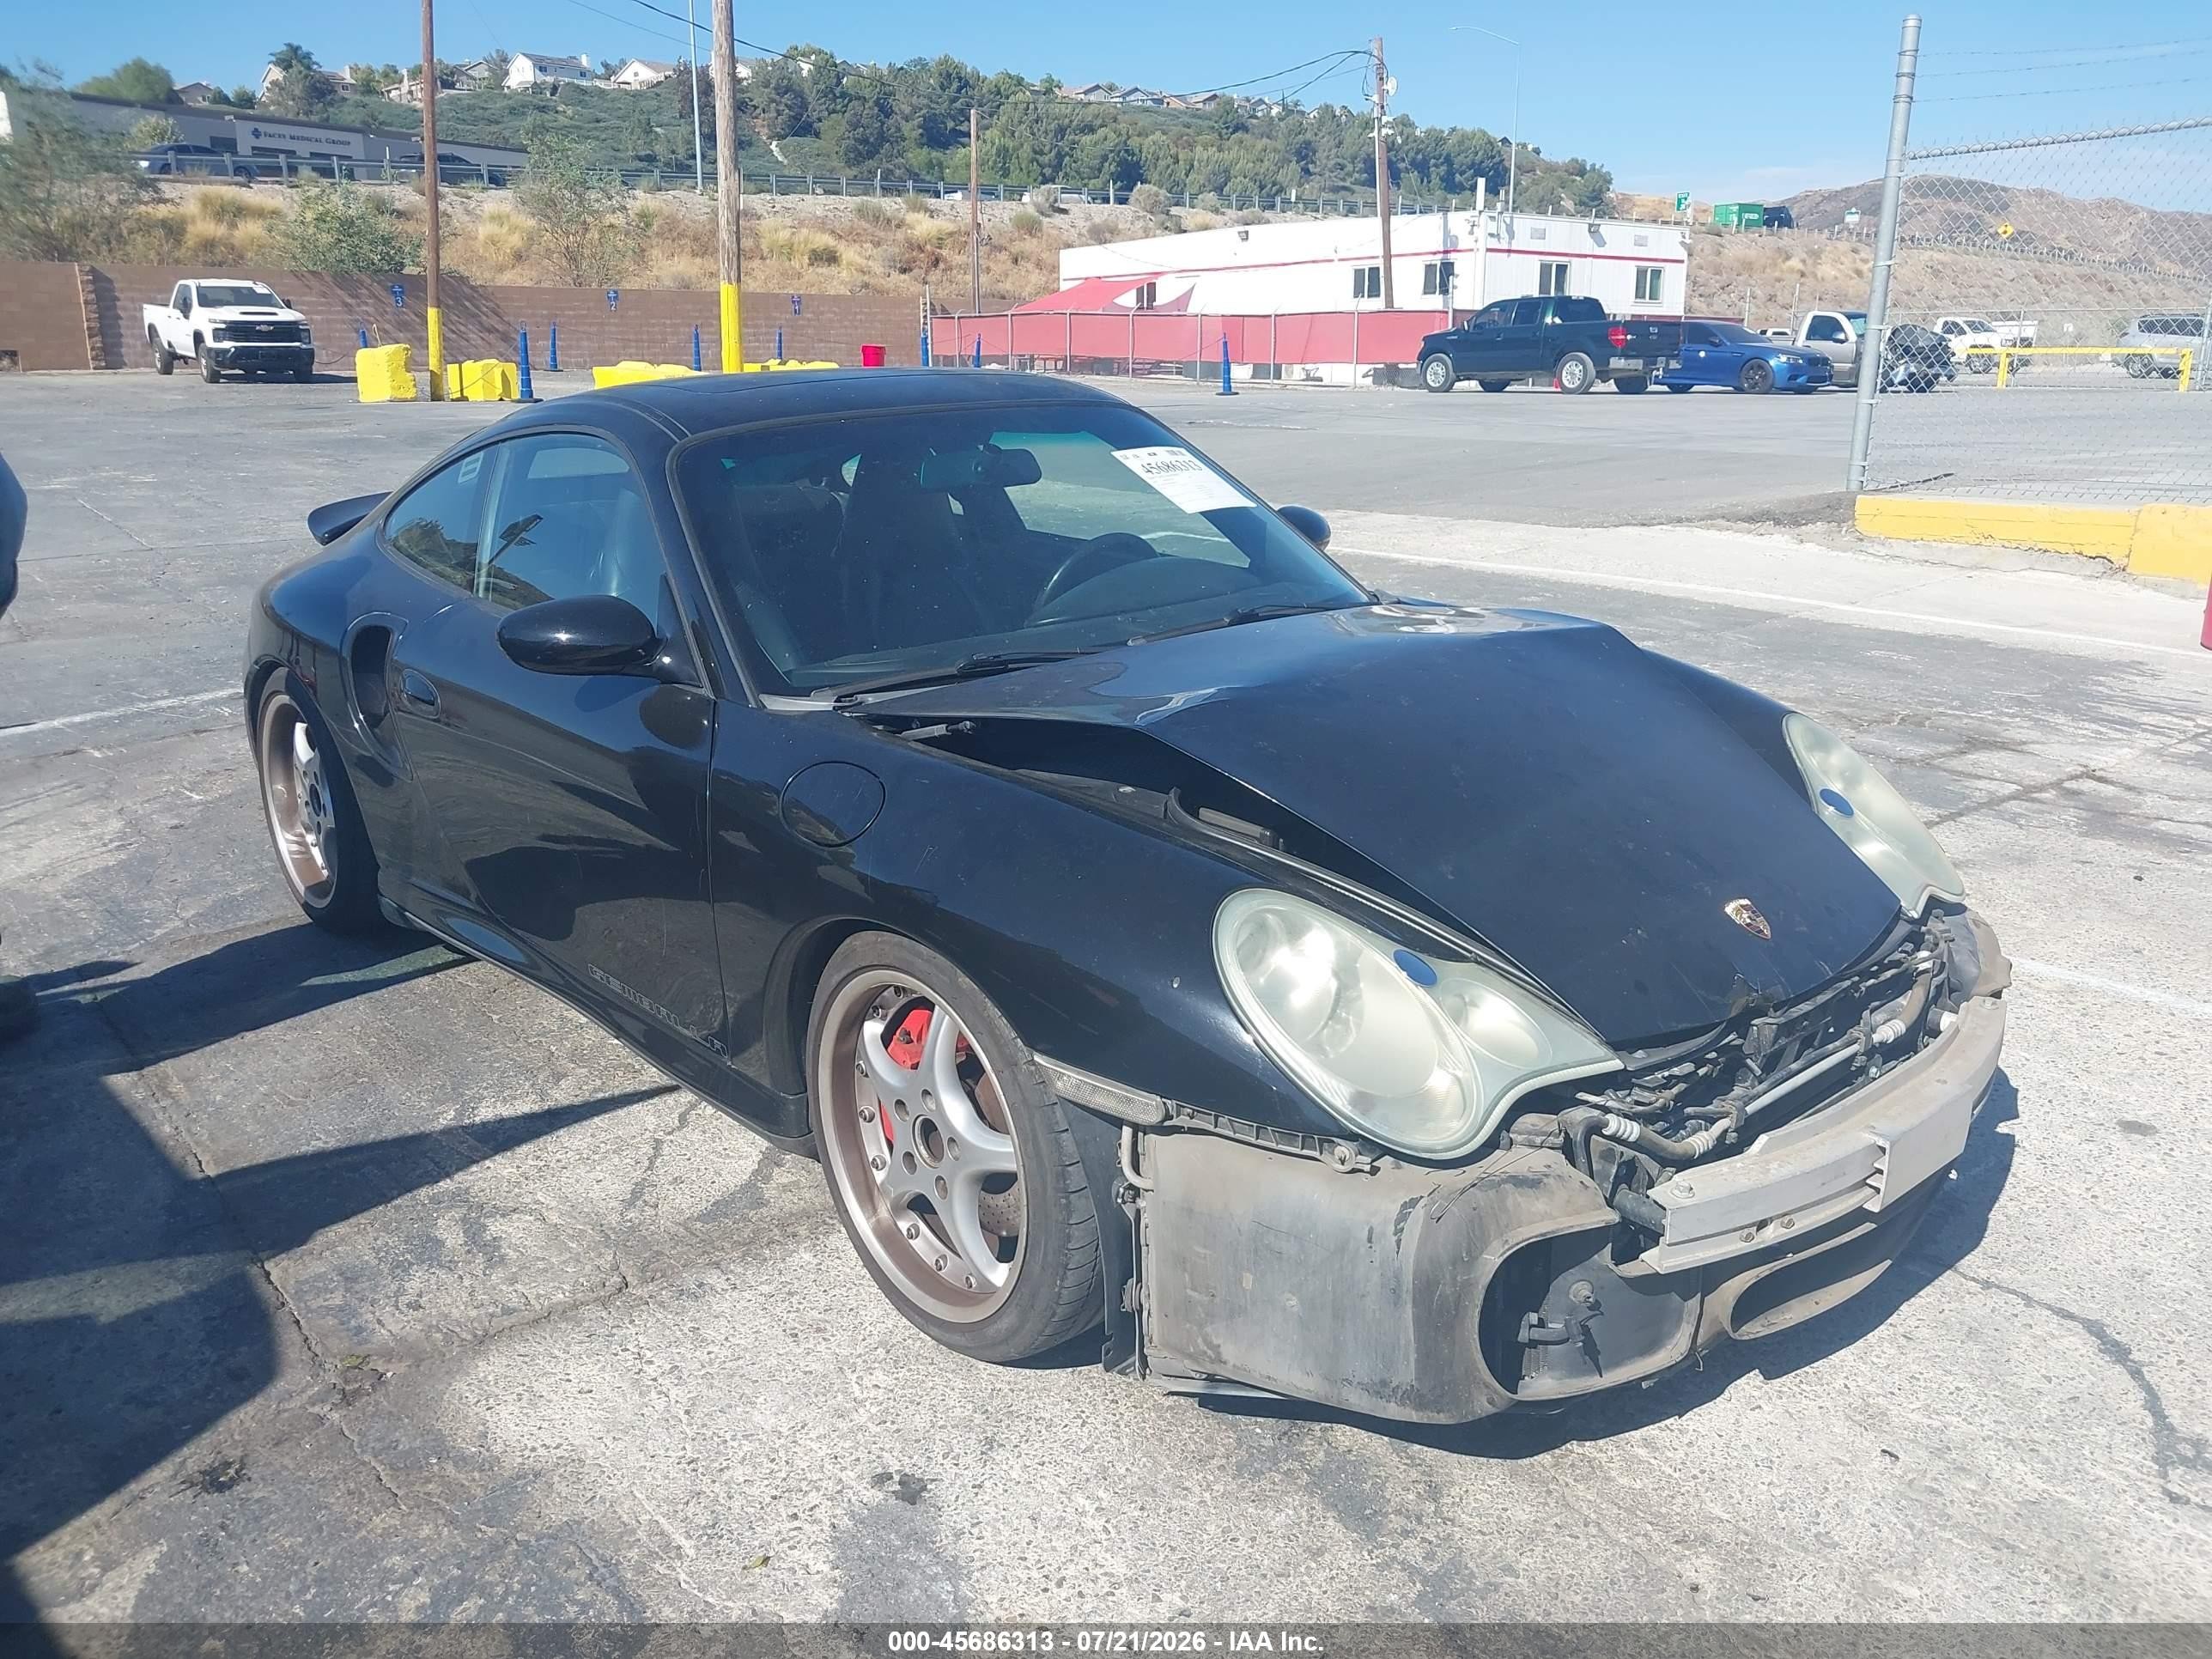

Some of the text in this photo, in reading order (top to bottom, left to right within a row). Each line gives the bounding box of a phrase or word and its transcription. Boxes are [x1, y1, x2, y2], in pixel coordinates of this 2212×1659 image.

[396, 296, 403, 307] 3
[610, 301, 617, 310] 2
[1141, 459, 1203, 475] 45686313
